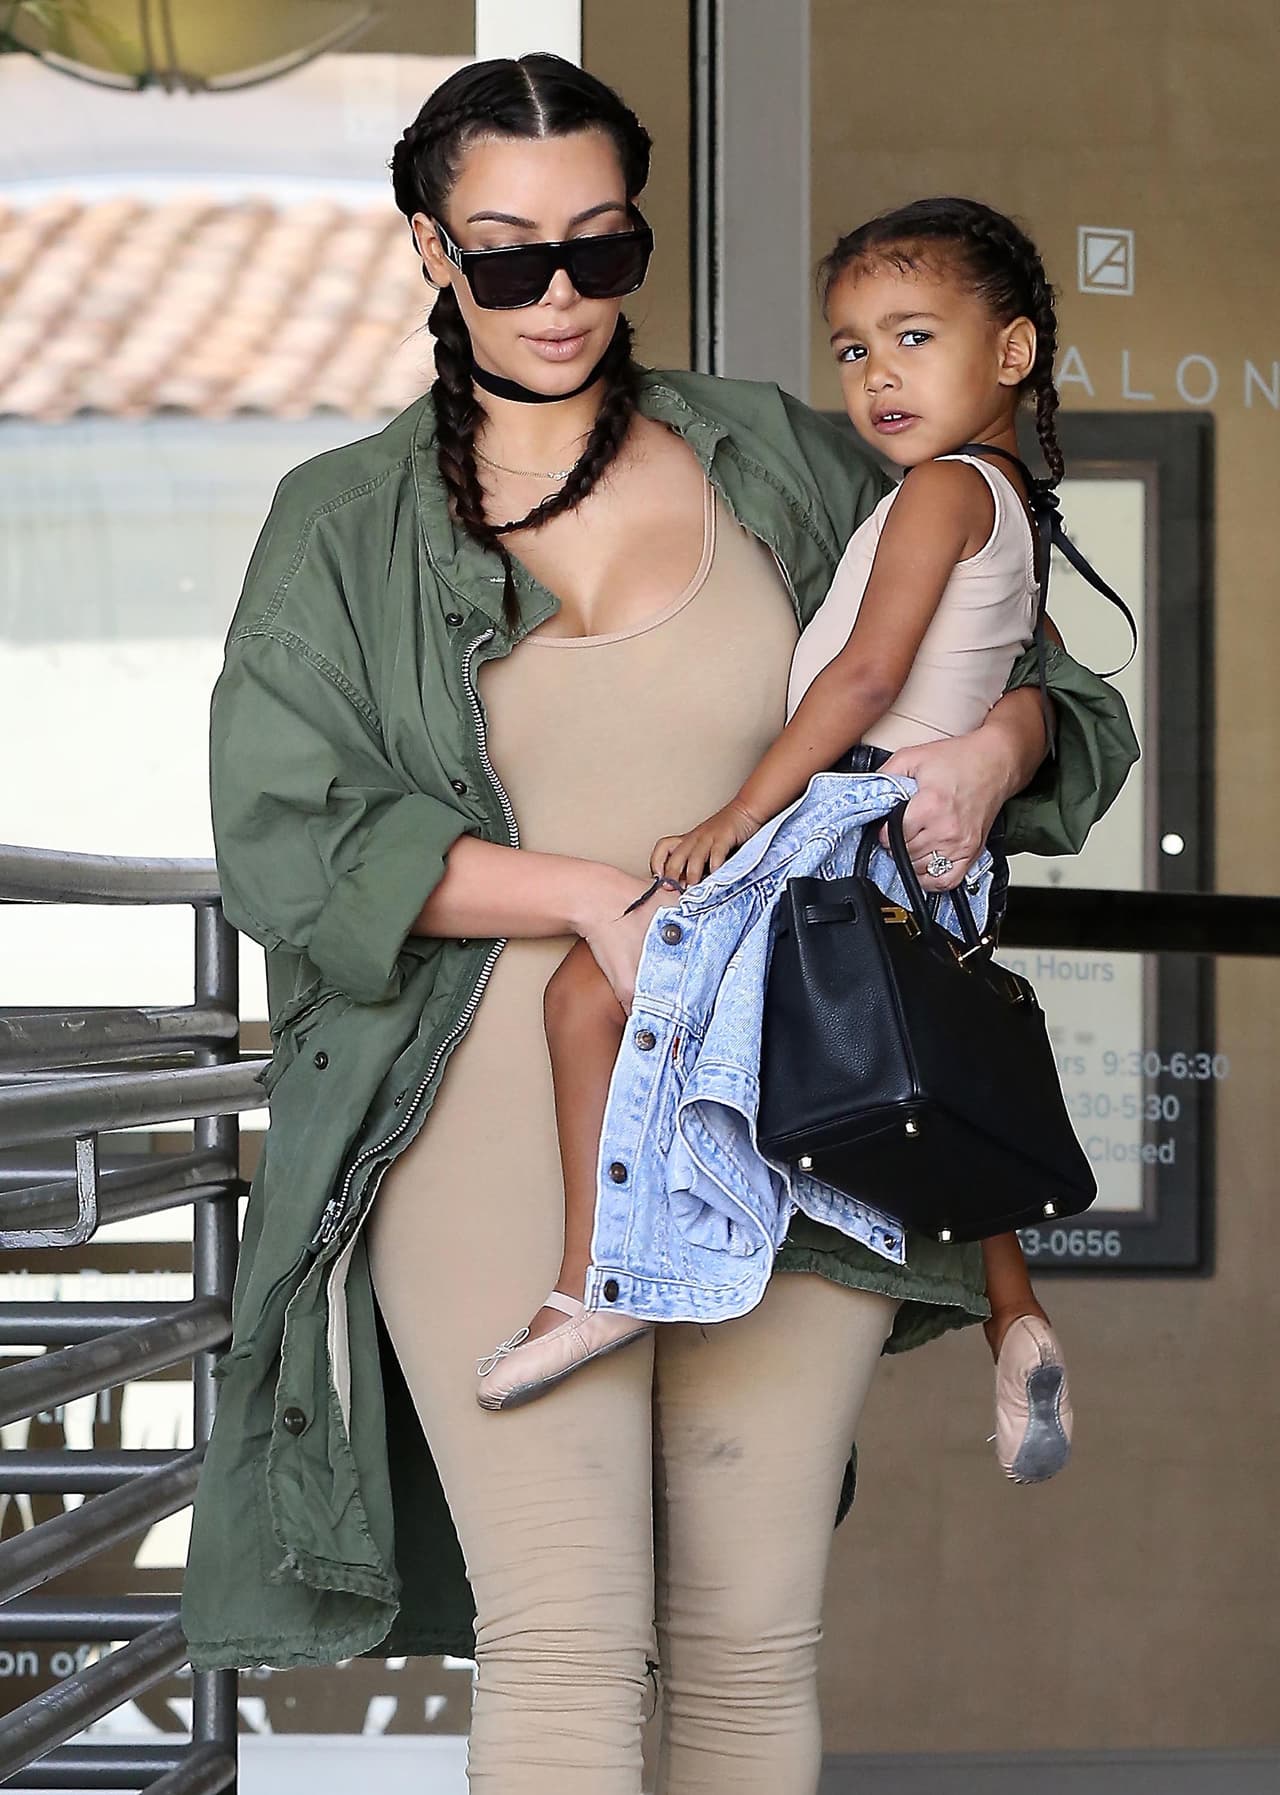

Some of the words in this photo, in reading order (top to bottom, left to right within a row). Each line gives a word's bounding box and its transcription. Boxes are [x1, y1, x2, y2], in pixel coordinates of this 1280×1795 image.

[1057, 345, 1280, 409] ALON
[1037, 954, 1114, 982] Hours
[1057, 1054, 1086, 1077] rs
[1102, 1051, 1229, 1080] 9:30-6:30
[1086, 1135, 1176, 1165] Closed
[1016, 1228, 1121, 1256] 3-0656
